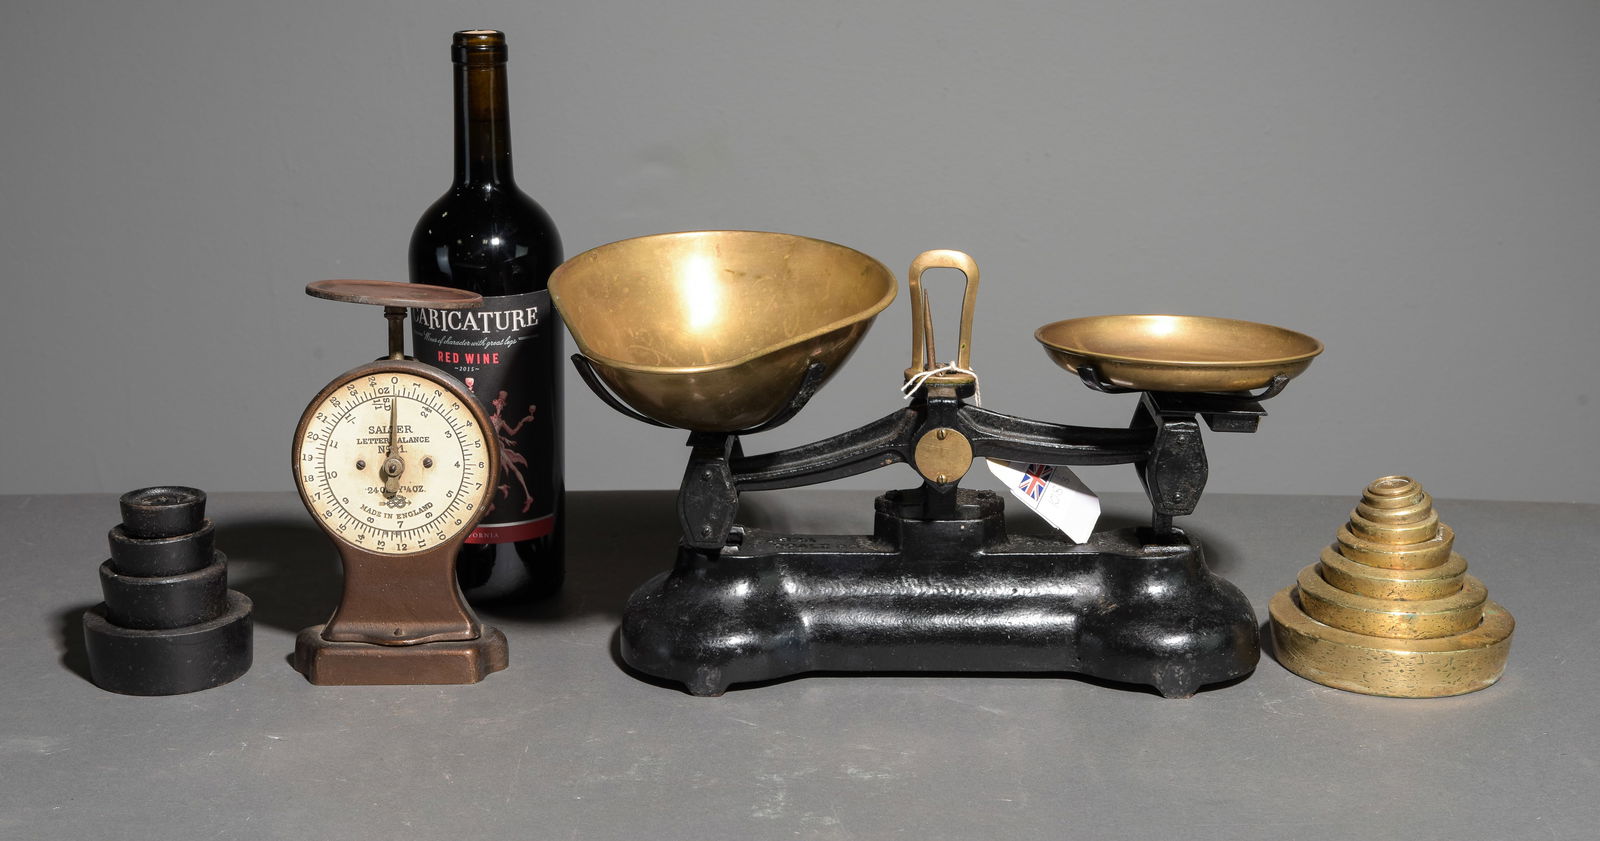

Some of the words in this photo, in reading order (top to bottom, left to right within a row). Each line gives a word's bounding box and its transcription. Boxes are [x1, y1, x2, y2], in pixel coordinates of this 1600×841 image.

[413, 307, 539, 333] CARICATURE
[437, 351, 460, 363] RED
[465, 352, 500, 365] WINE
[368, 376, 377, 387] 24
[347, 384, 358, 396] 23
[378, 387, 390, 395] OZ
[434, 389, 442, 397] 2
[329, 396, 341, 408] 22
[452, 402, 460, 411] 3
[316, 412, 328, 423] 21
[368, 425, 414, 434] SALER
[445, 430, 452, 438] 3
[307, 431, 319, 441] 20
[395, 436, 430, 444] ALANCE
[329, 440, 338, 448] 11
[474, 439, 481, 449] 5
[302, 453, 314, 462] 19
[303, 474, 314, 483] 18
[327, 471, 338, 479] 10
[475, 482, 482, 490] 7
[309, 492, 321, 503] 17
[360, 504, 382, 518] MADE
[396, 501, 434, 519] ENGLAND
[466, 503, 473, 511] 8
[322, 510, 333, 520] 16
[454, 518, 462, 526] 9
[336, 523, 347, 534] 15
[355, 534, 365, 544] 14
[436, 530, 447, 541] 10
[376, 540, 386, 551] 13
[396, 543, 407, 551] 12
[418, 539, 426, 548] 11
